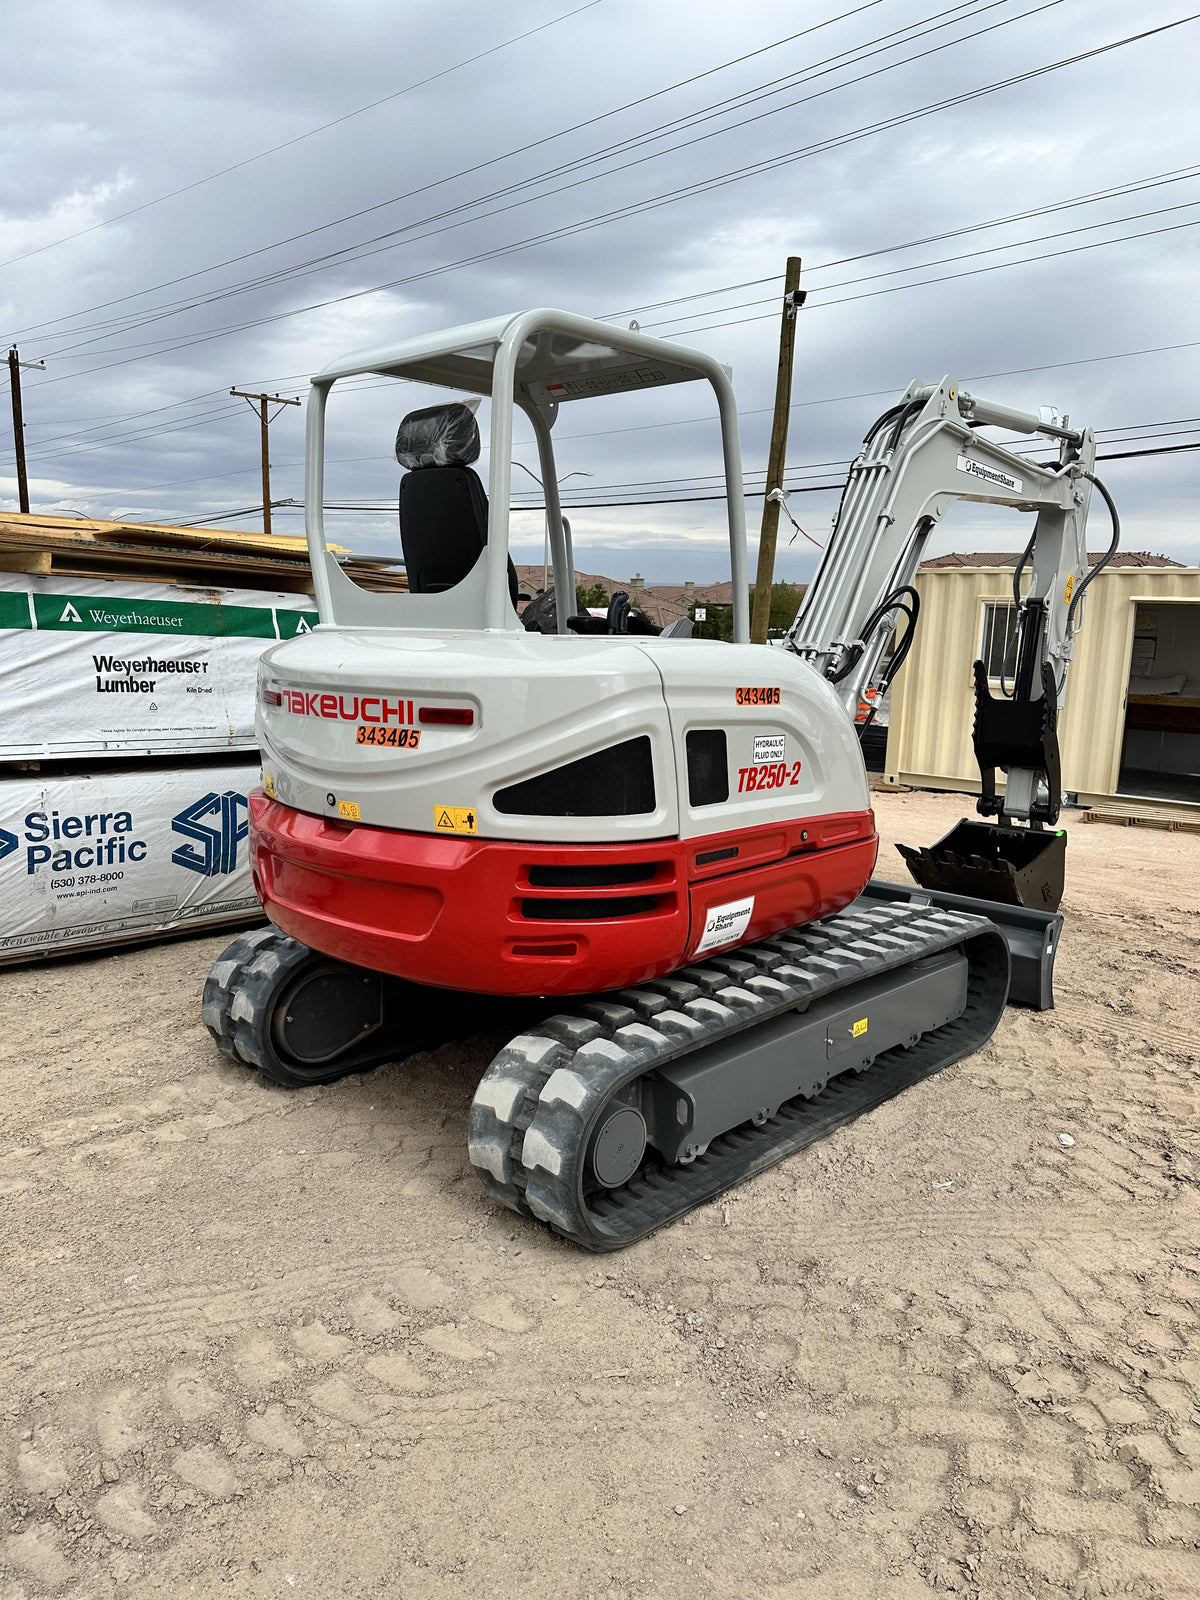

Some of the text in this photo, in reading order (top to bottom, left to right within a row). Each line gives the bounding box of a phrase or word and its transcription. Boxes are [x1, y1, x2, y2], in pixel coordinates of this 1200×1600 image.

[972, 462, 1015, 488] EquipmentShare
[89, 609, 183, 627] Weyerhaeuser
[92, 655, 208, 676] Weyerhaeuser
[96, 675, 156, 693] Lumber
[736, 687, 780, 705] 343405
[283, 690, 413, 725] TAKEUCHI
[357, 726, 420, 748] 343405
[755, 739, 784, 748] HYDRAULIC
[755, 750, 783, 760] FLUID ONLY
[738, 761, 801, 792] TB250-2
[24, 810, 133, 842] Sierra
[27, 835, 147, 875] Pacific
[50, 871, 124, 889] (530) 378-8000
[56, 886, 118, 899] www.spi-ind.com
[716, 907, 751, 924] Equipment
[1, 923, 109, 947] Renewable Resource
[714, 921, 734, 932] Share
